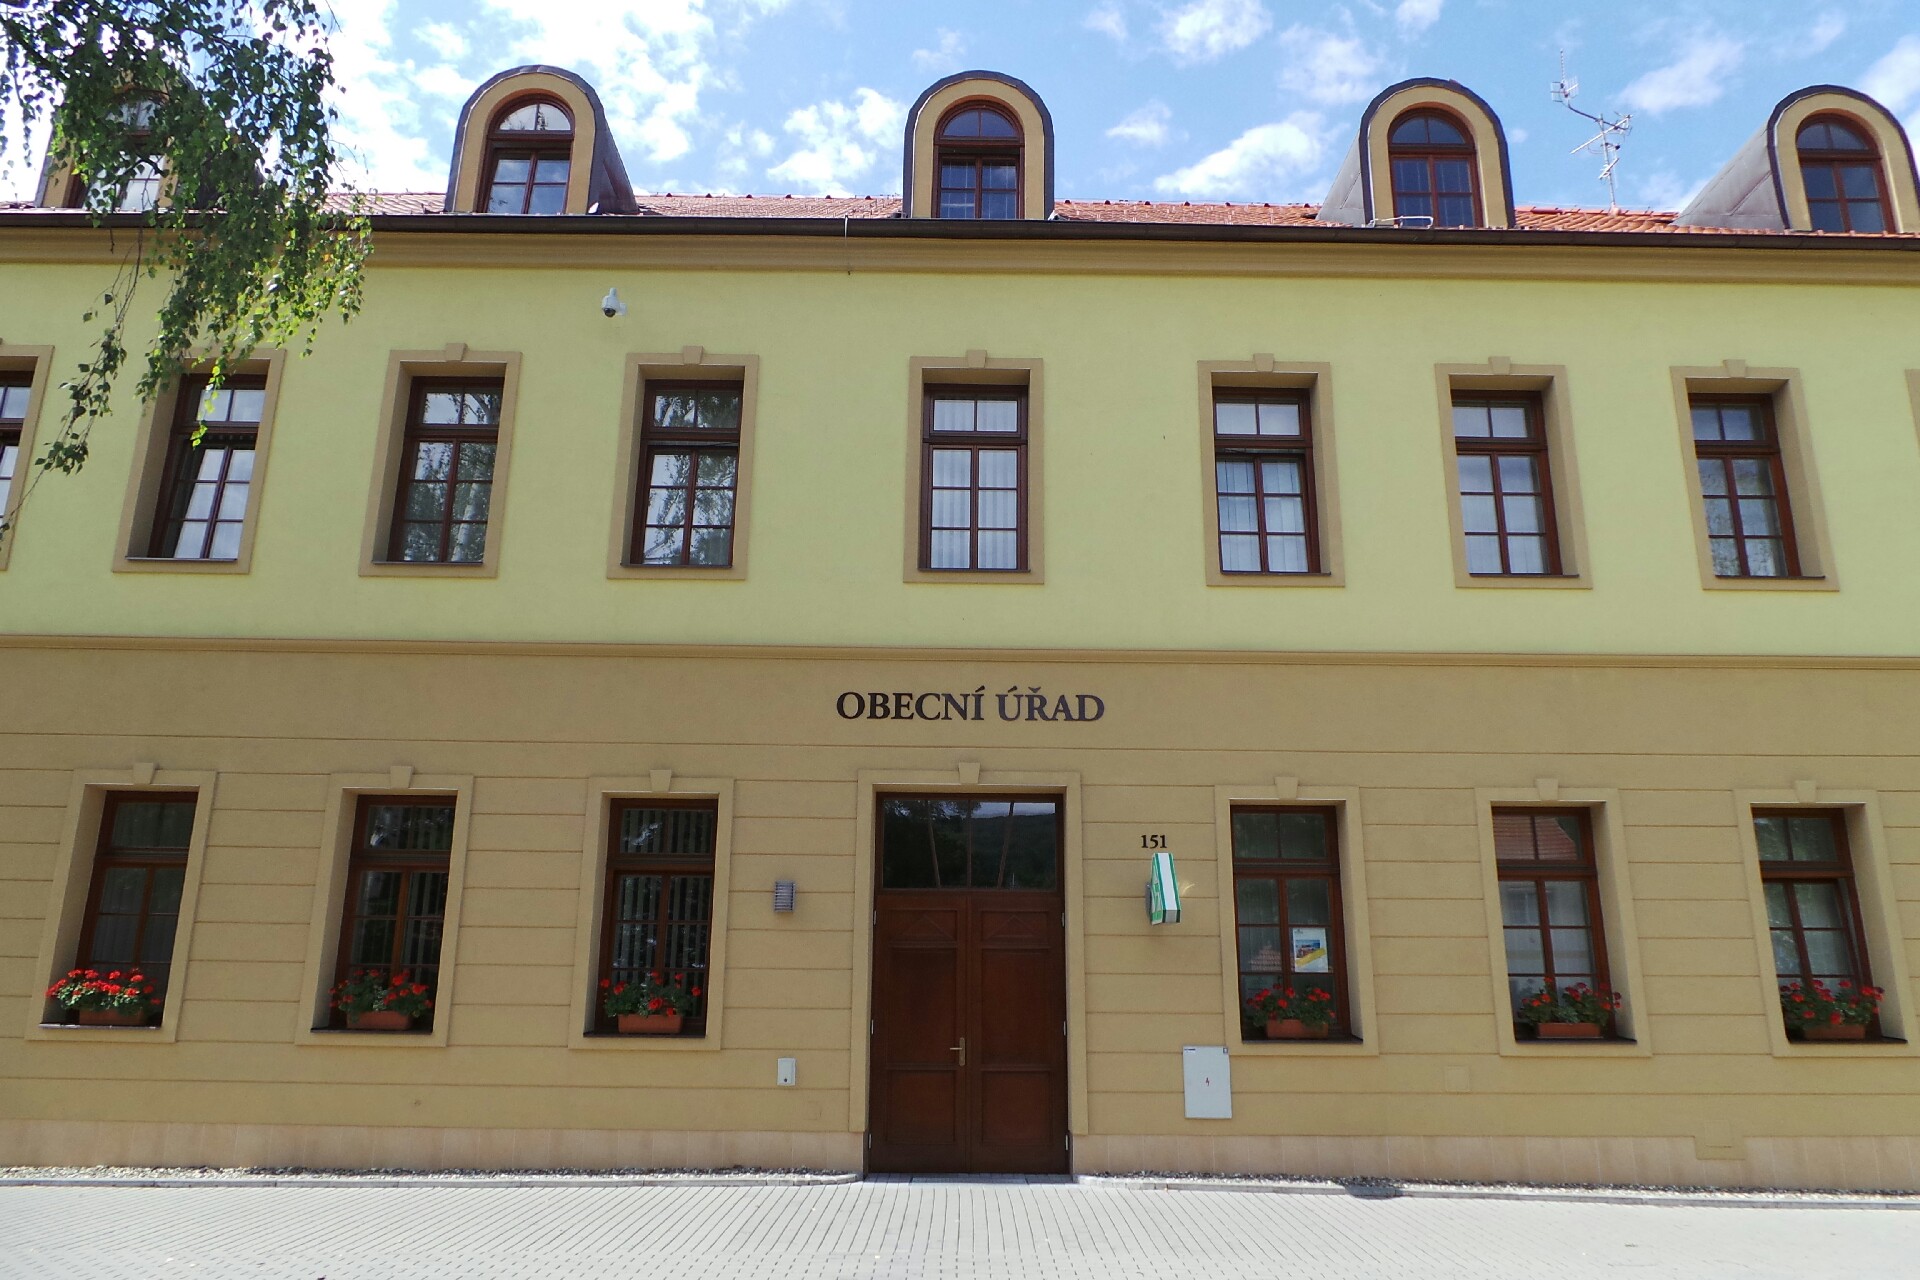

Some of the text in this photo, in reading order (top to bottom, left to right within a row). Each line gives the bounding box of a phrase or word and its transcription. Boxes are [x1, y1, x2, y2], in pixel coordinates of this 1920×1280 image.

[836, 685, 1105, 722] OBECNÍ ÚŘAD
[1141, 834, 1168, 849] 151
